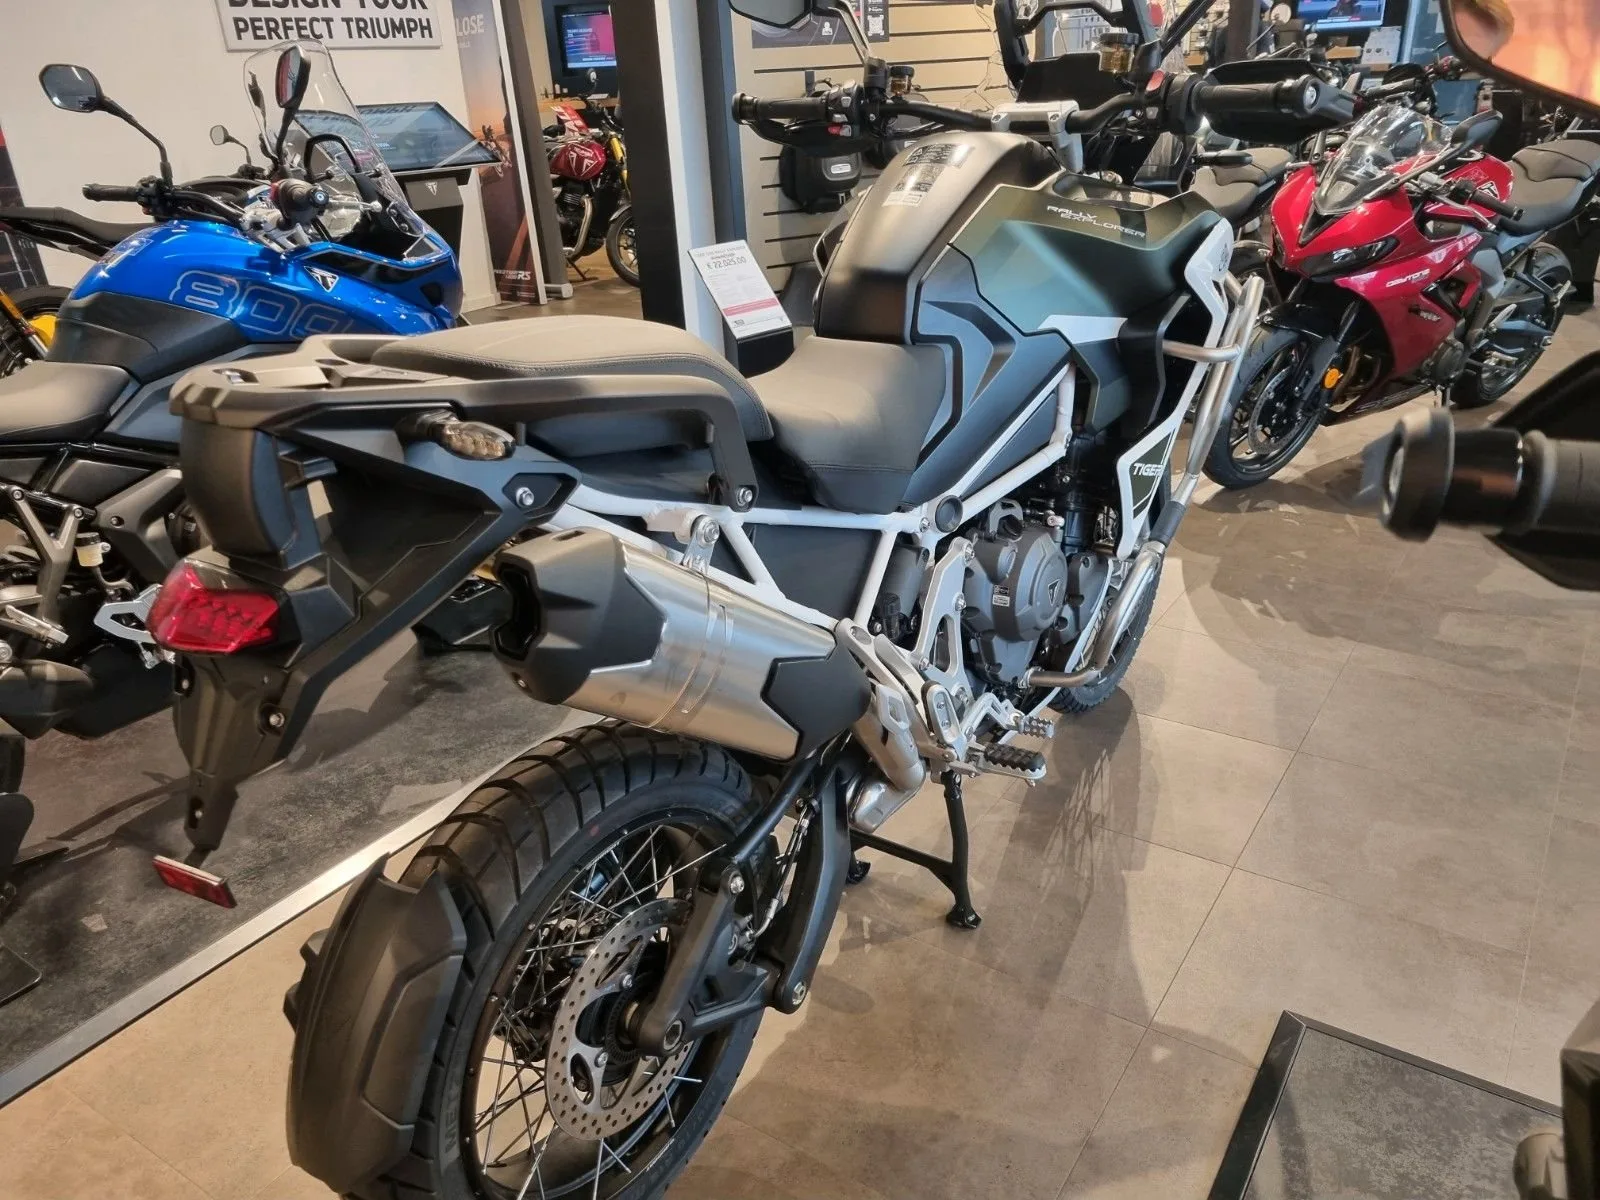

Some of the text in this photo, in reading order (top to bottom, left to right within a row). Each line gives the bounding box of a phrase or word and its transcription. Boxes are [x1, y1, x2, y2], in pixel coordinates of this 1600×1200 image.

[232, 16, 433, 40] PERFECT TRIUMPH
[1046, 205, 1098, 220] RALLY
[1060, 212, 1146, 238] EXPLORER
[517, 271, 531, 280] RS
[1133, 462, 1164, 477] TIGER
